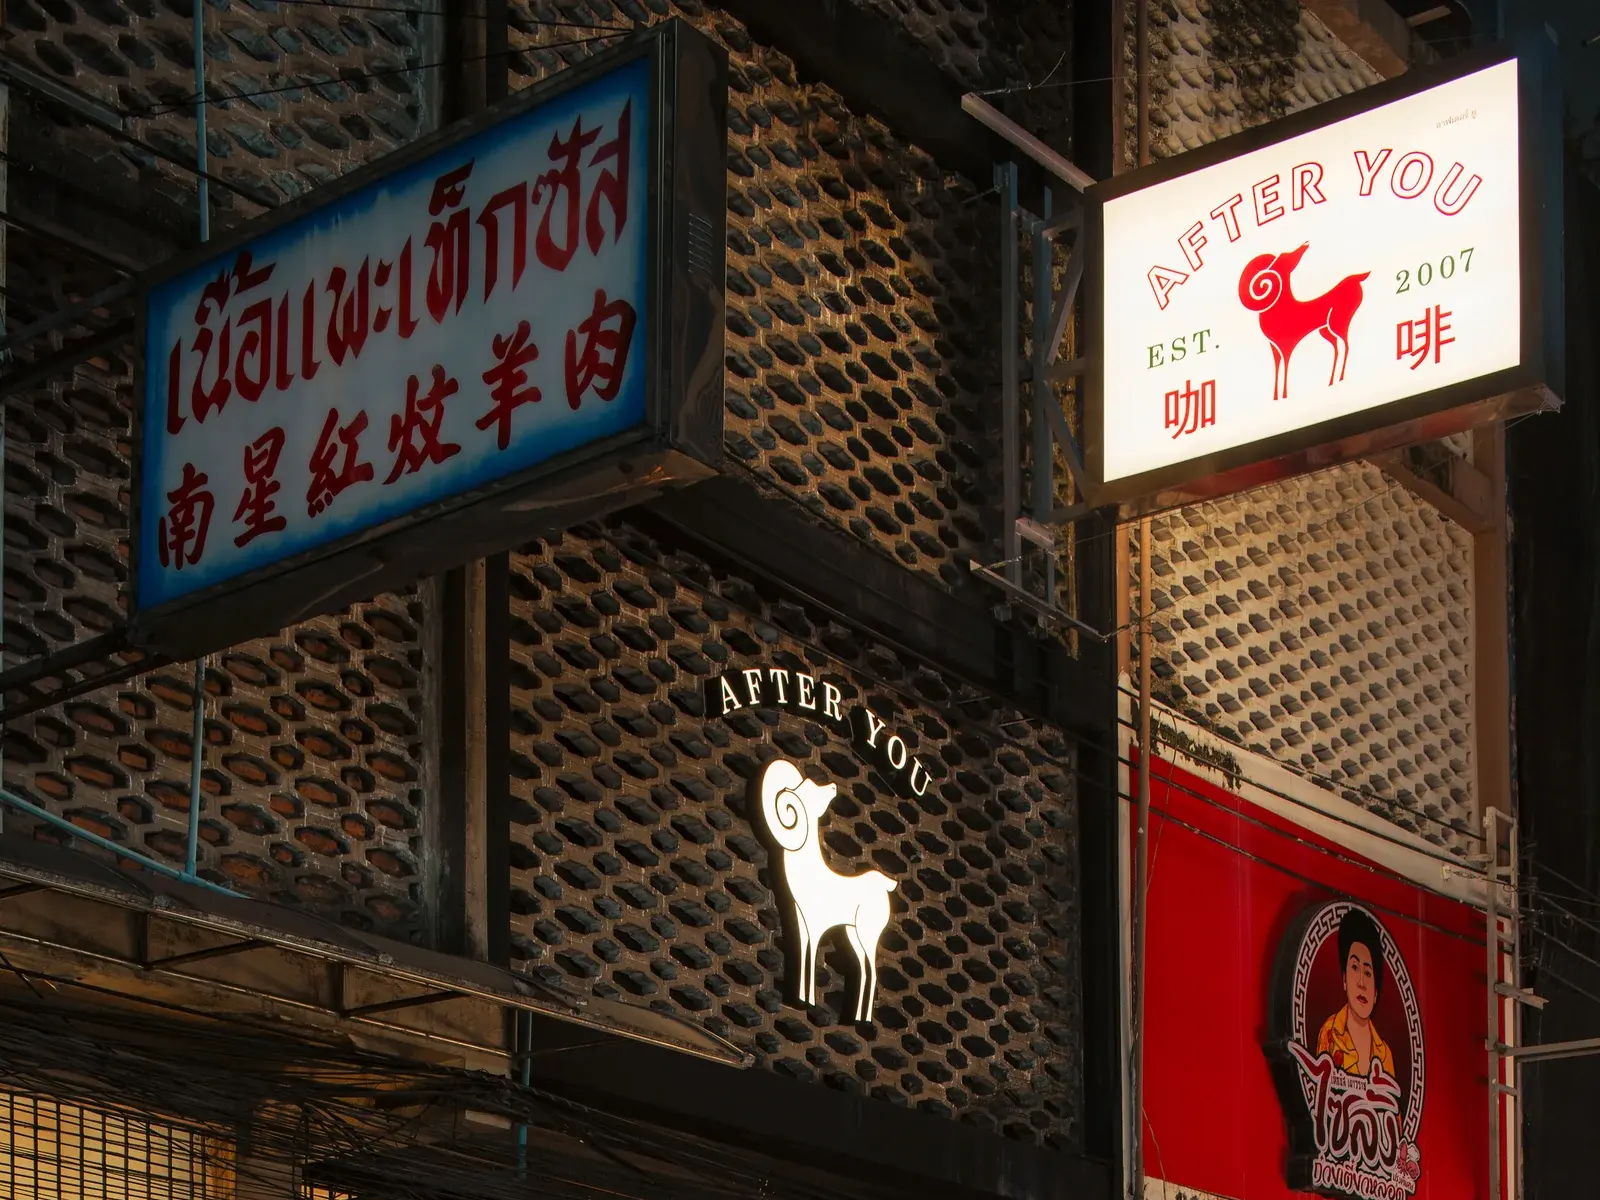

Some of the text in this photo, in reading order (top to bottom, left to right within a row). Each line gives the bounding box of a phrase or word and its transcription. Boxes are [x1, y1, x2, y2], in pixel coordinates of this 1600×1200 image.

[1147, 148, 1482, 310] AFTER YOU
[1146, 247, 1476, 370] EST. 2007
[1164, 304, 1456, 440] 咖 啡
[720, 668, 933, 796] AFTER YOU
